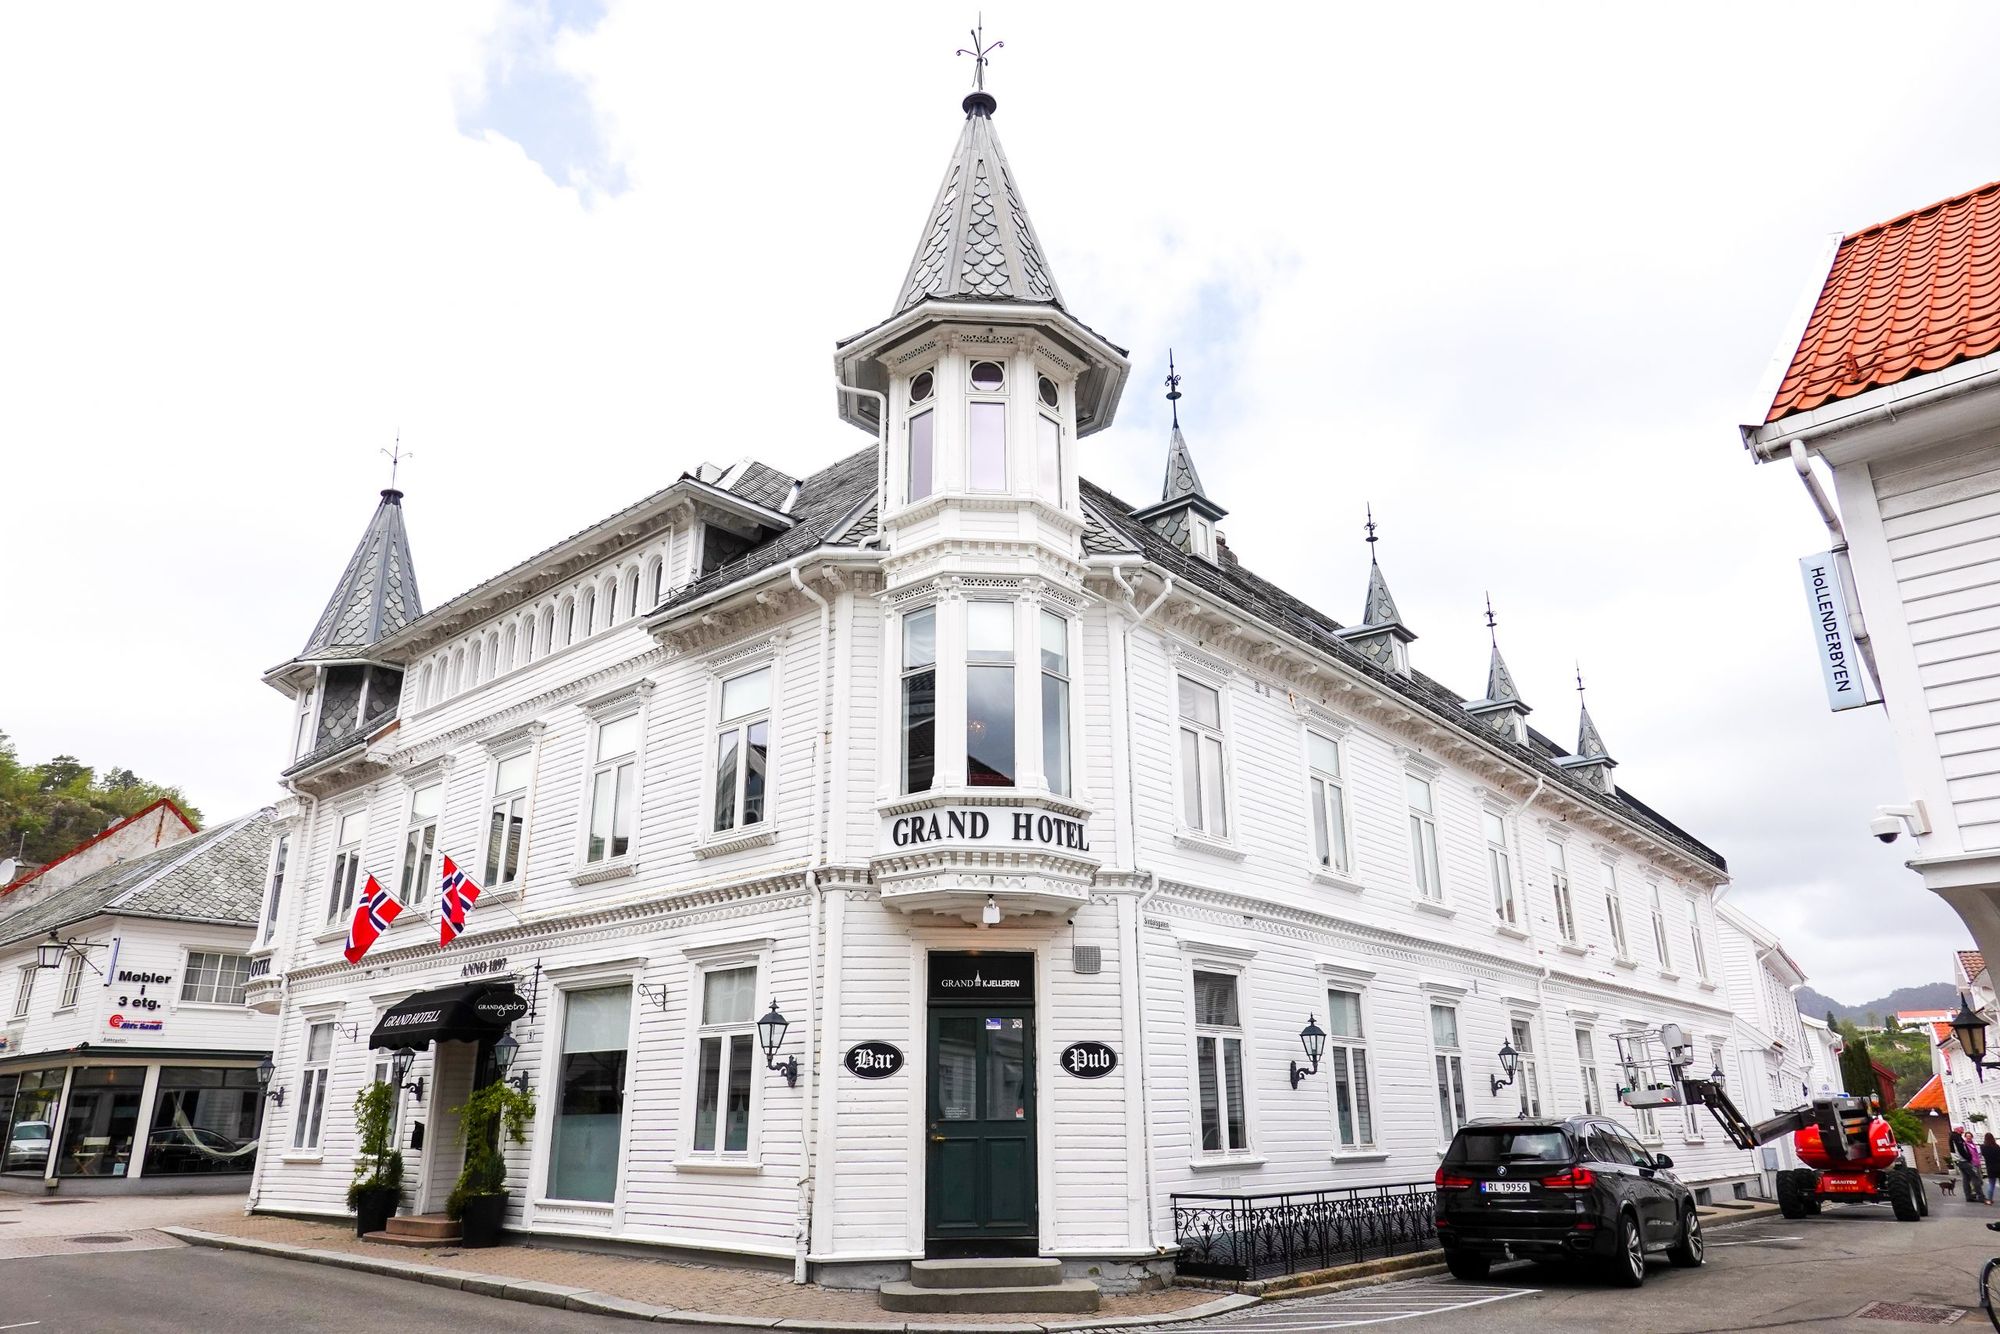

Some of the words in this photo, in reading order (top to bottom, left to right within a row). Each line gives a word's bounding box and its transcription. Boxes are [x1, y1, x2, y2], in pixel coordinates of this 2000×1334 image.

[892, 810, 989, 847] GRAND
[1012, 813, 1090, 851] HOTEL
[461, 962, 487, 977] ANNO
[488, 958, 507, 973] 1897
[119, 971, 172, 983] Møbler
[941, 979, 974, 987] GRAND
[140, 985, 146, 995] i
[118, 996, 128, 1007] 3
[132, 998, 161, 1011] etg.
[384, 1013, 413, 1028] GRAND
[412, 1010, 442, 1025] HOTELL
[854, 1048, 895, 1071] Bar
[1069, 1048, 1110, 1072] Pub
[1488, 1183, 1498, 1191] RL
[1502, 1183, 1527, 1191] 19956
